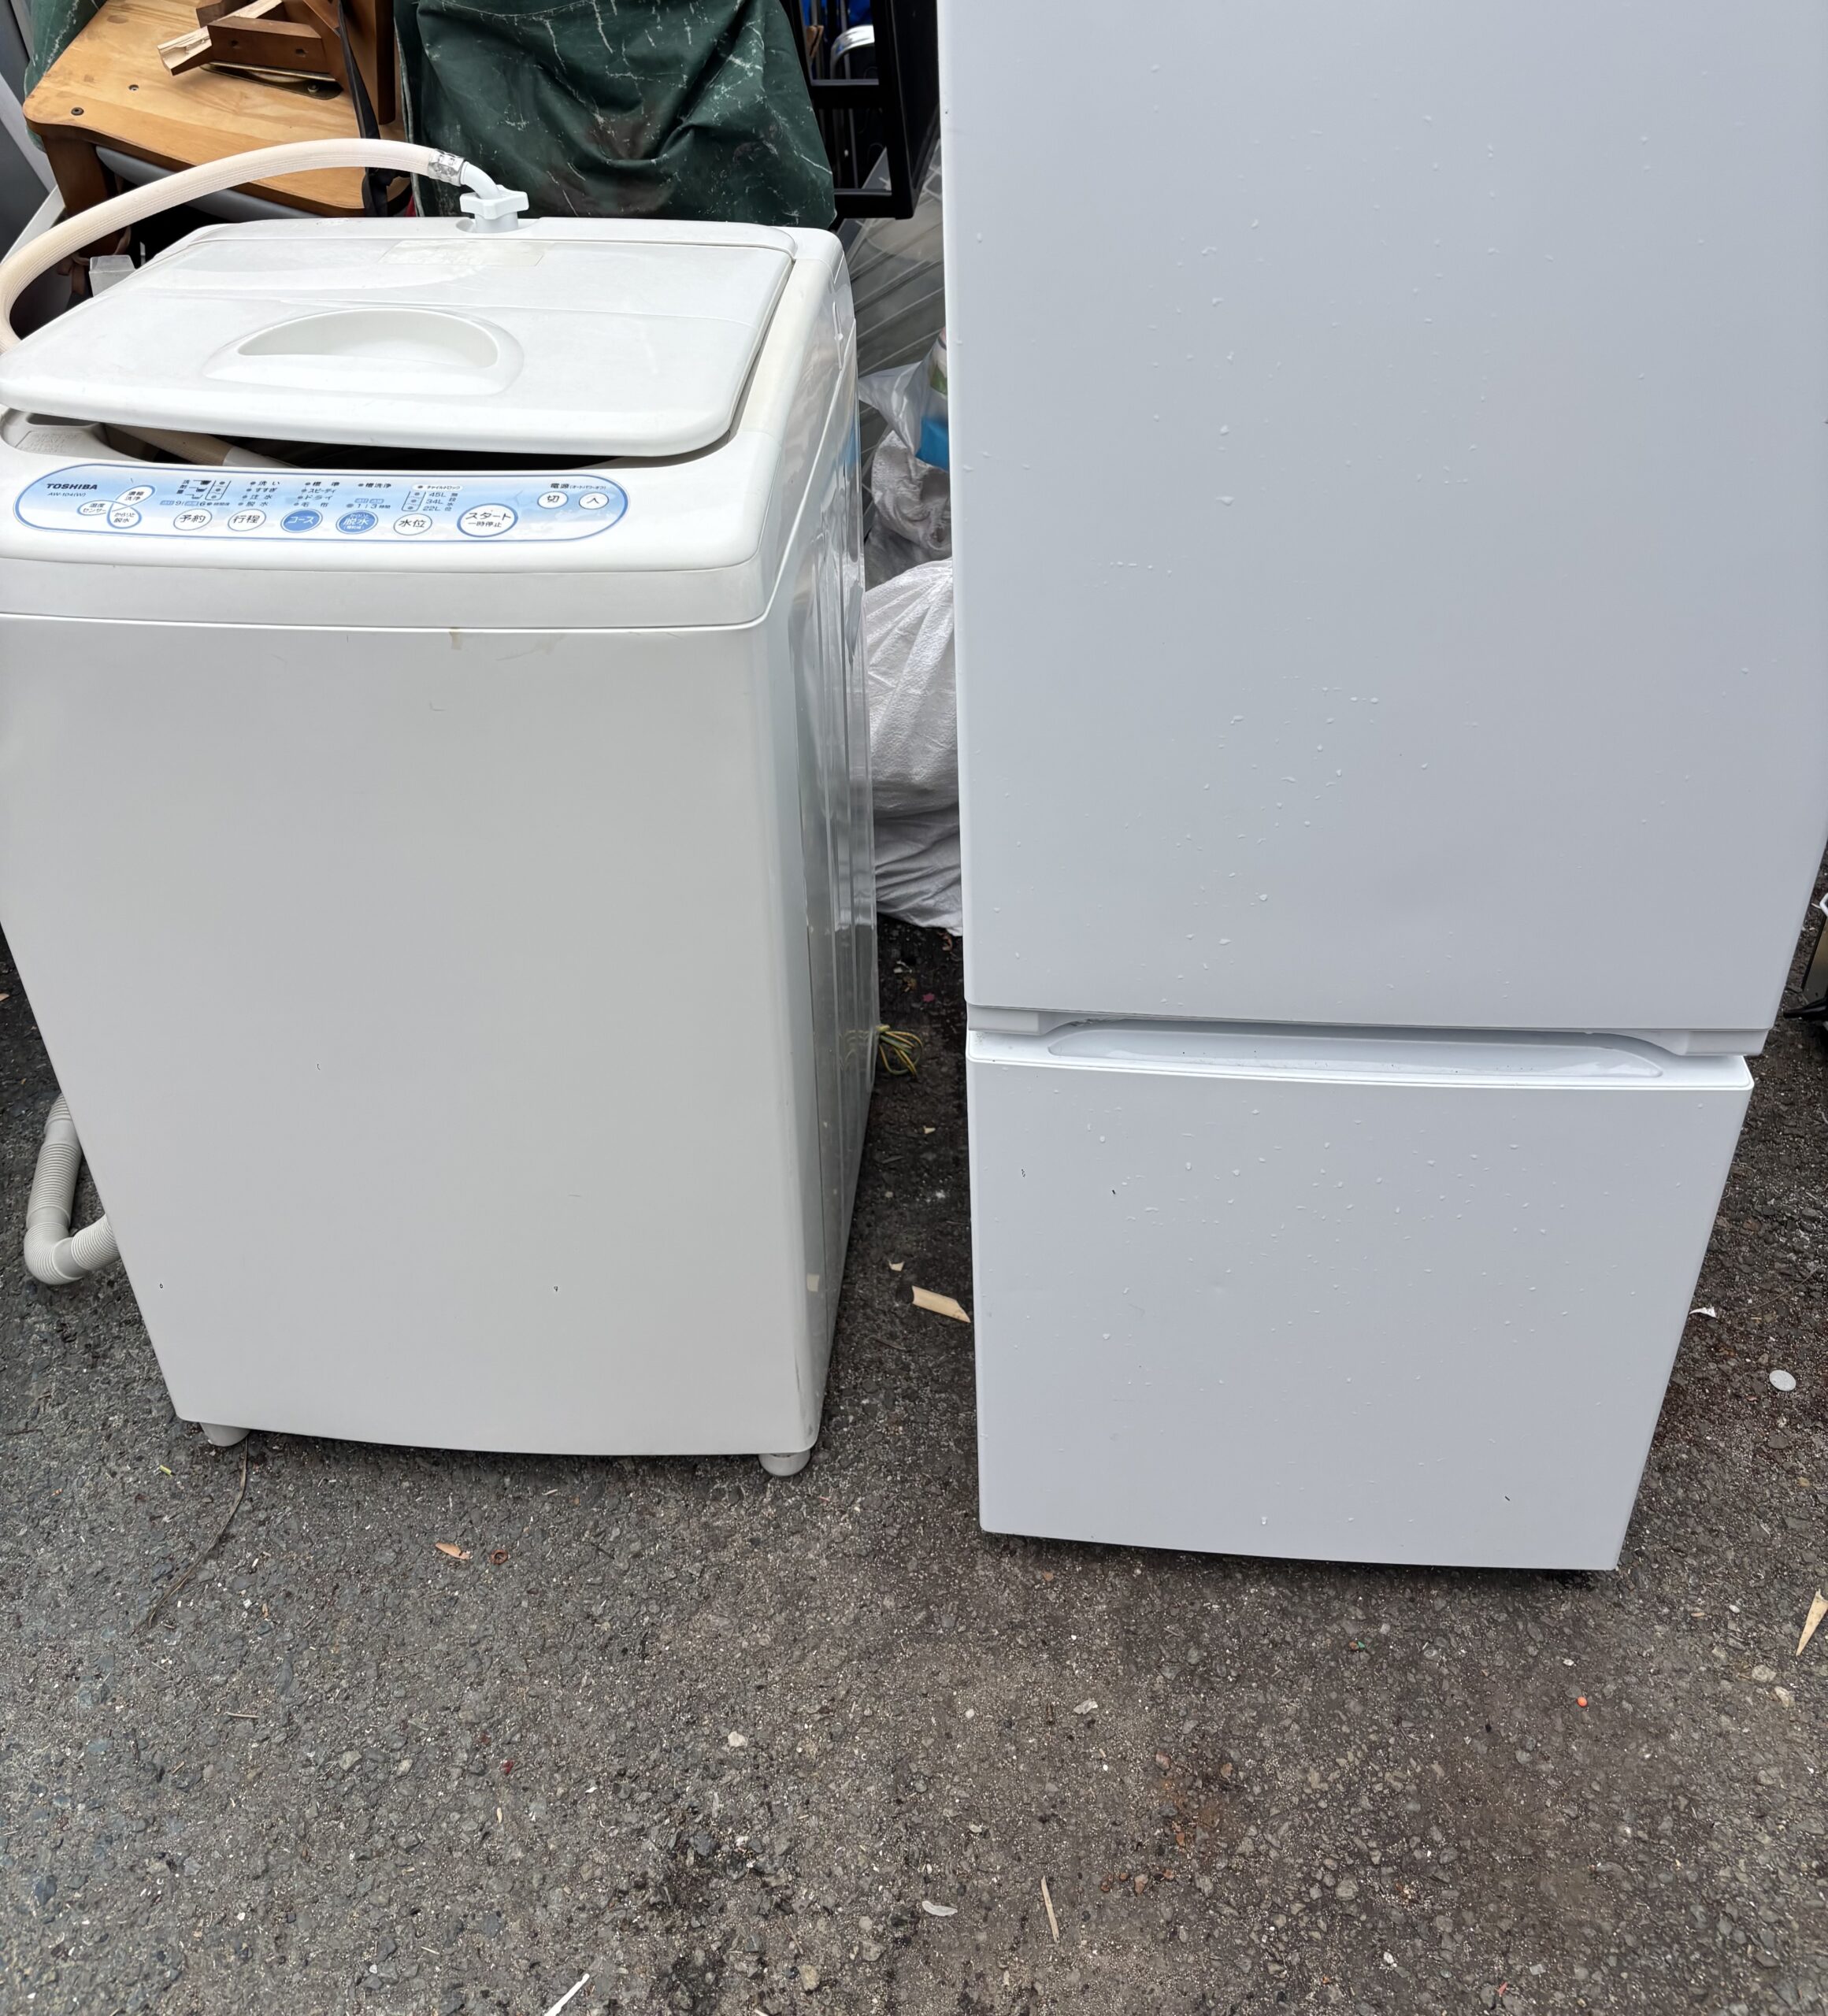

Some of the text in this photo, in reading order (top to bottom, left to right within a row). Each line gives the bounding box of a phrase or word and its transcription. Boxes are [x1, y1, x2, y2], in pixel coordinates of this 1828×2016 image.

[547, 495, 560, 503] 切
[179, 514, 206, 523] 予約
[233, 515, 261, 524] 行程
[287, 516, 315, 524] コース
[465, 512, 512, 521] スタート
[399, 519, 427, 528] 水位
